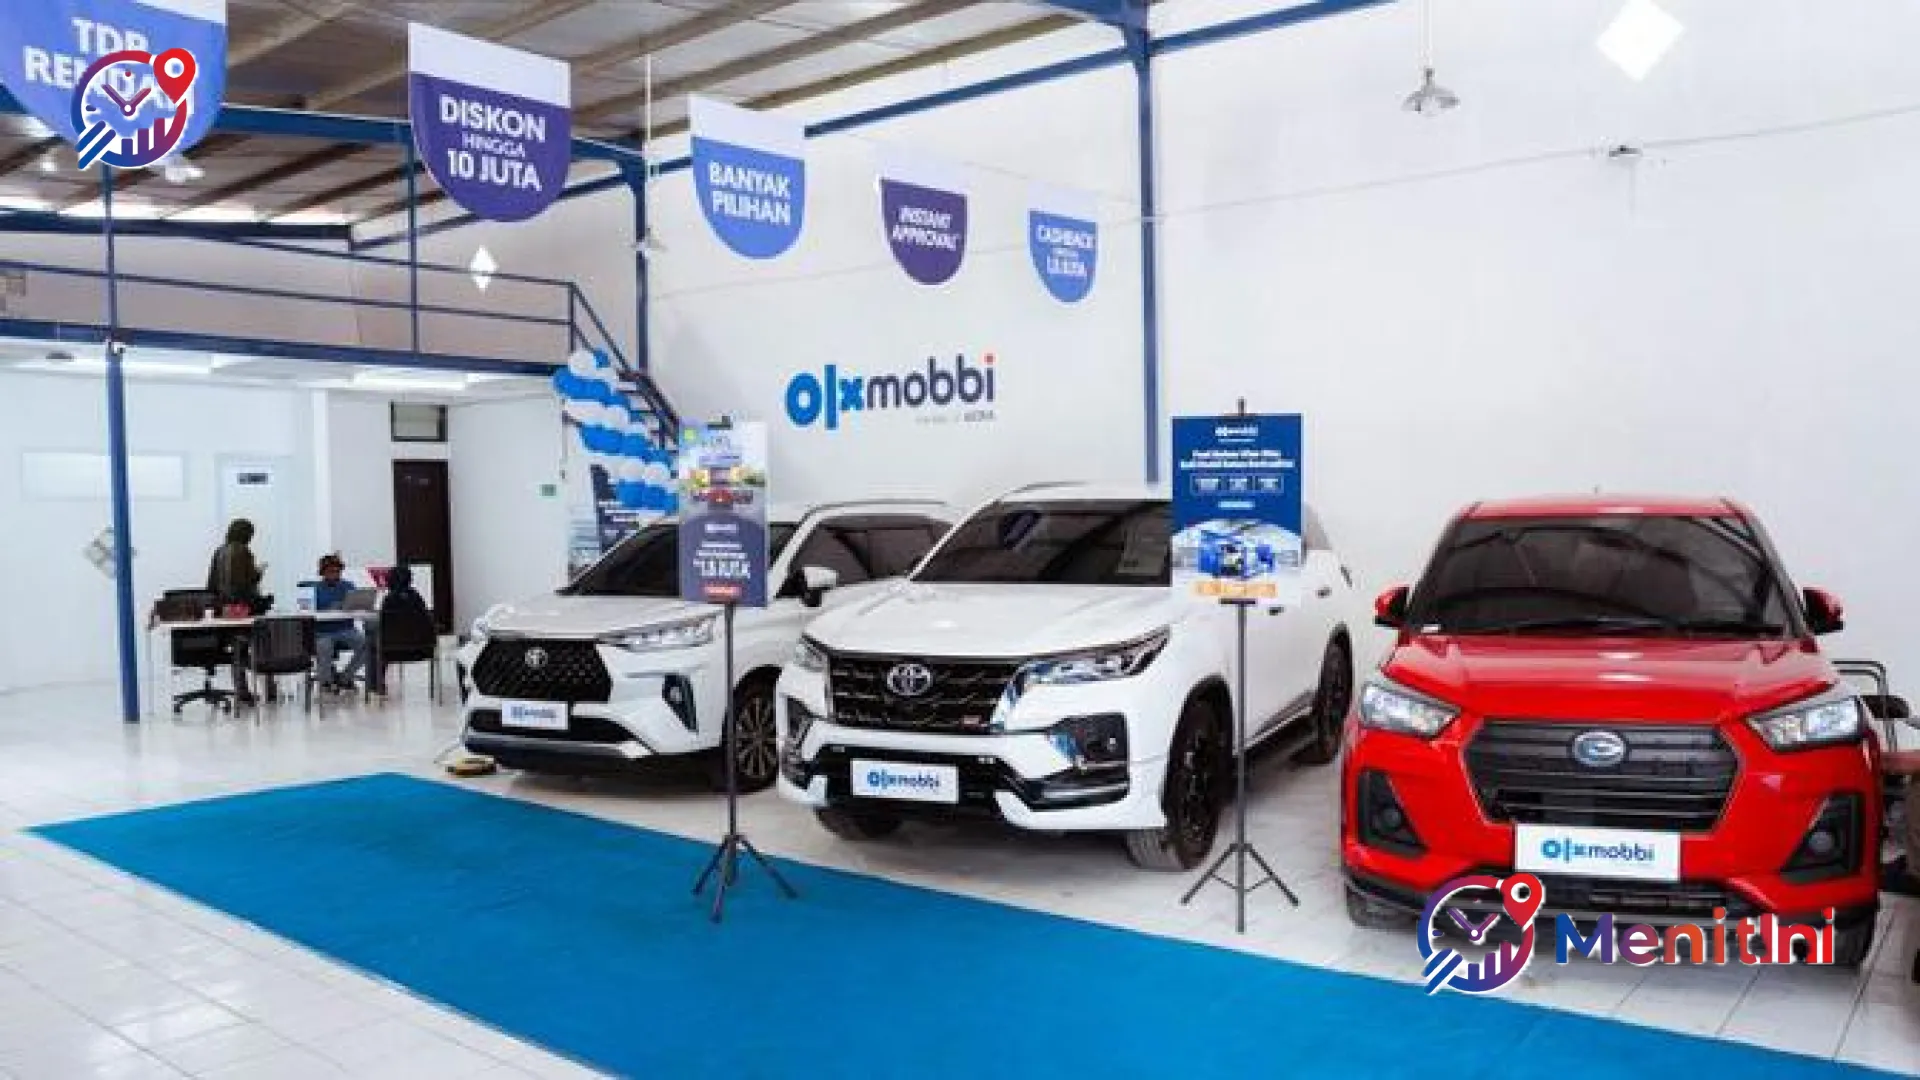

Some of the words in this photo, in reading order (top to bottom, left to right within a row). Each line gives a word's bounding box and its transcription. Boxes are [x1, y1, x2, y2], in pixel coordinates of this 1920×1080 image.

[440, 94, 546, 143] DISKON
[461, 131, 526, 158] HINGGA
[447, 148, 475, 180] 10
[479, 155, 543, 192] JUTA
[708, 161, 791, 199] BANYAK
[711, 190, 791, 226] PILIHAN
[785, 352, 996, 431] olxmobbi
[1540, 837, 1655, 864] olxmobbi
